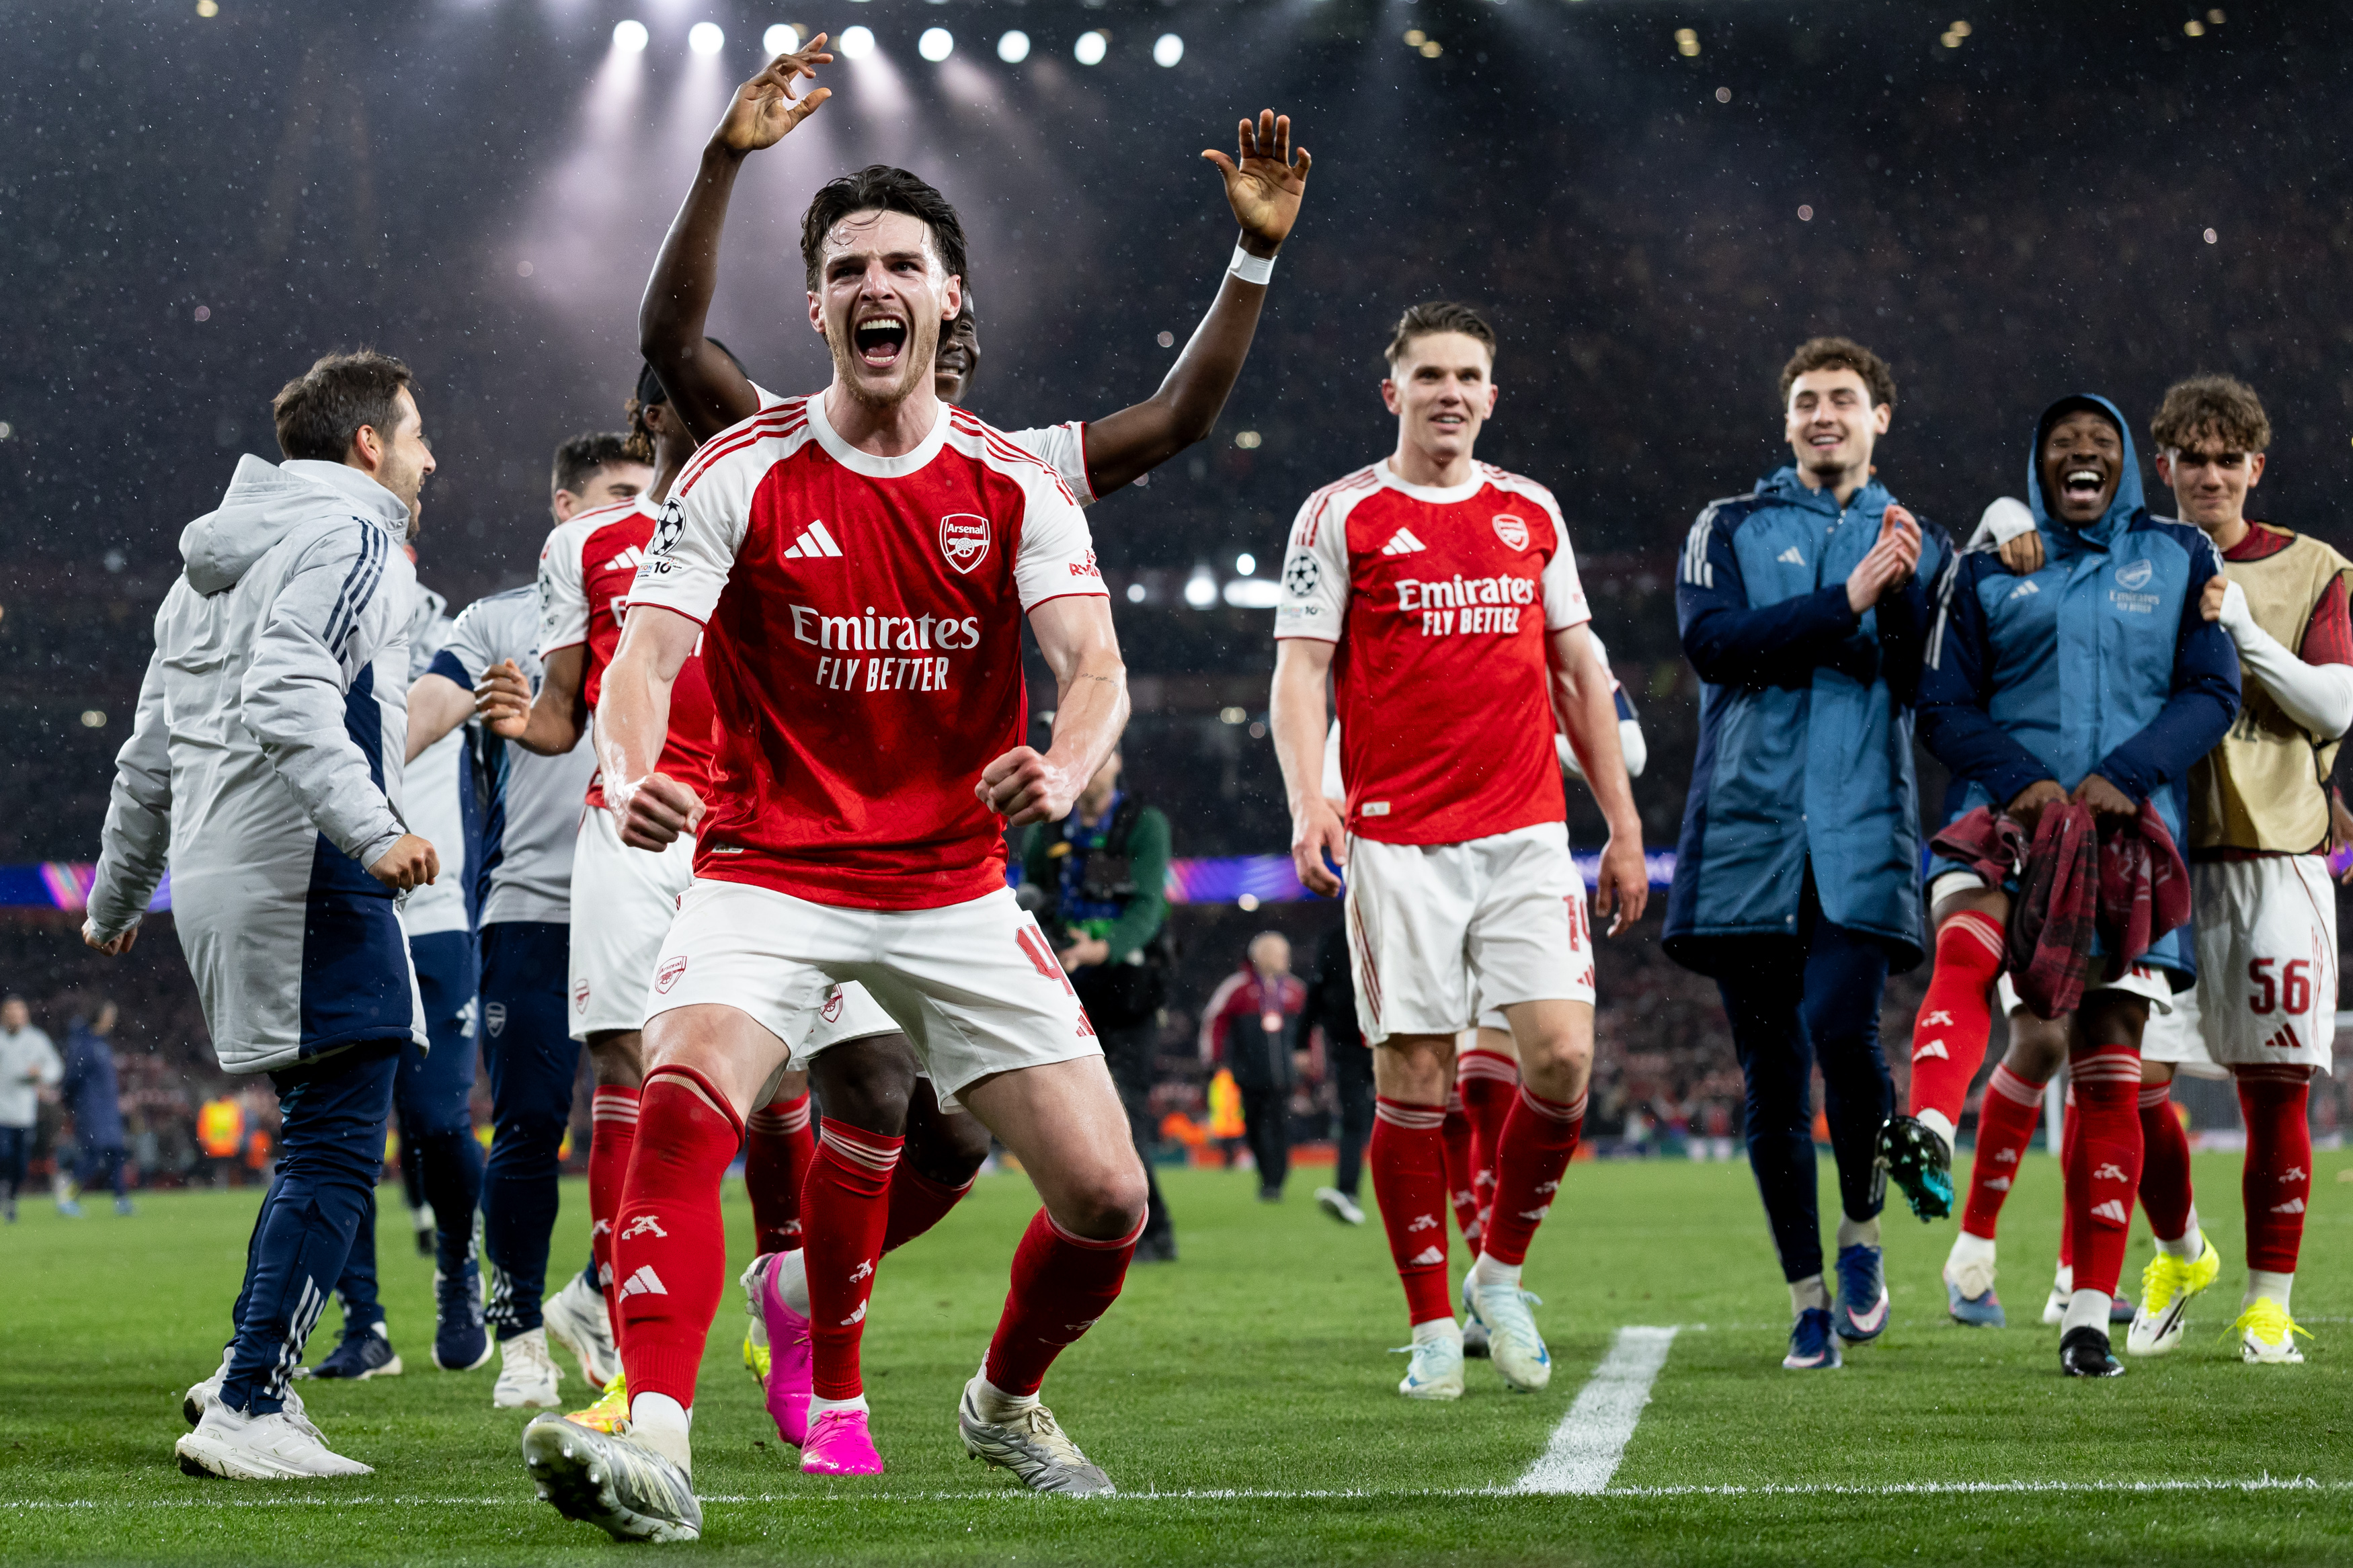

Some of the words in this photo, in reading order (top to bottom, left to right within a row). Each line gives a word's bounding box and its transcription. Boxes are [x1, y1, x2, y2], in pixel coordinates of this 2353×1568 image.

[947, 523, 983, 535] Arsenal
[654, 561, 672, 574] 10
[1394, 573, 1535, 612] Emirates
[789, 604, 980, 651] Emirates
[1421, 610, 1454, 636] FLY
[815, 656, 861, 691] FLY
[866, 657, 949, 692] BETTER
[1014, 923, 1076, 997] 4
[2249, 957, 2310, 1015] 56
